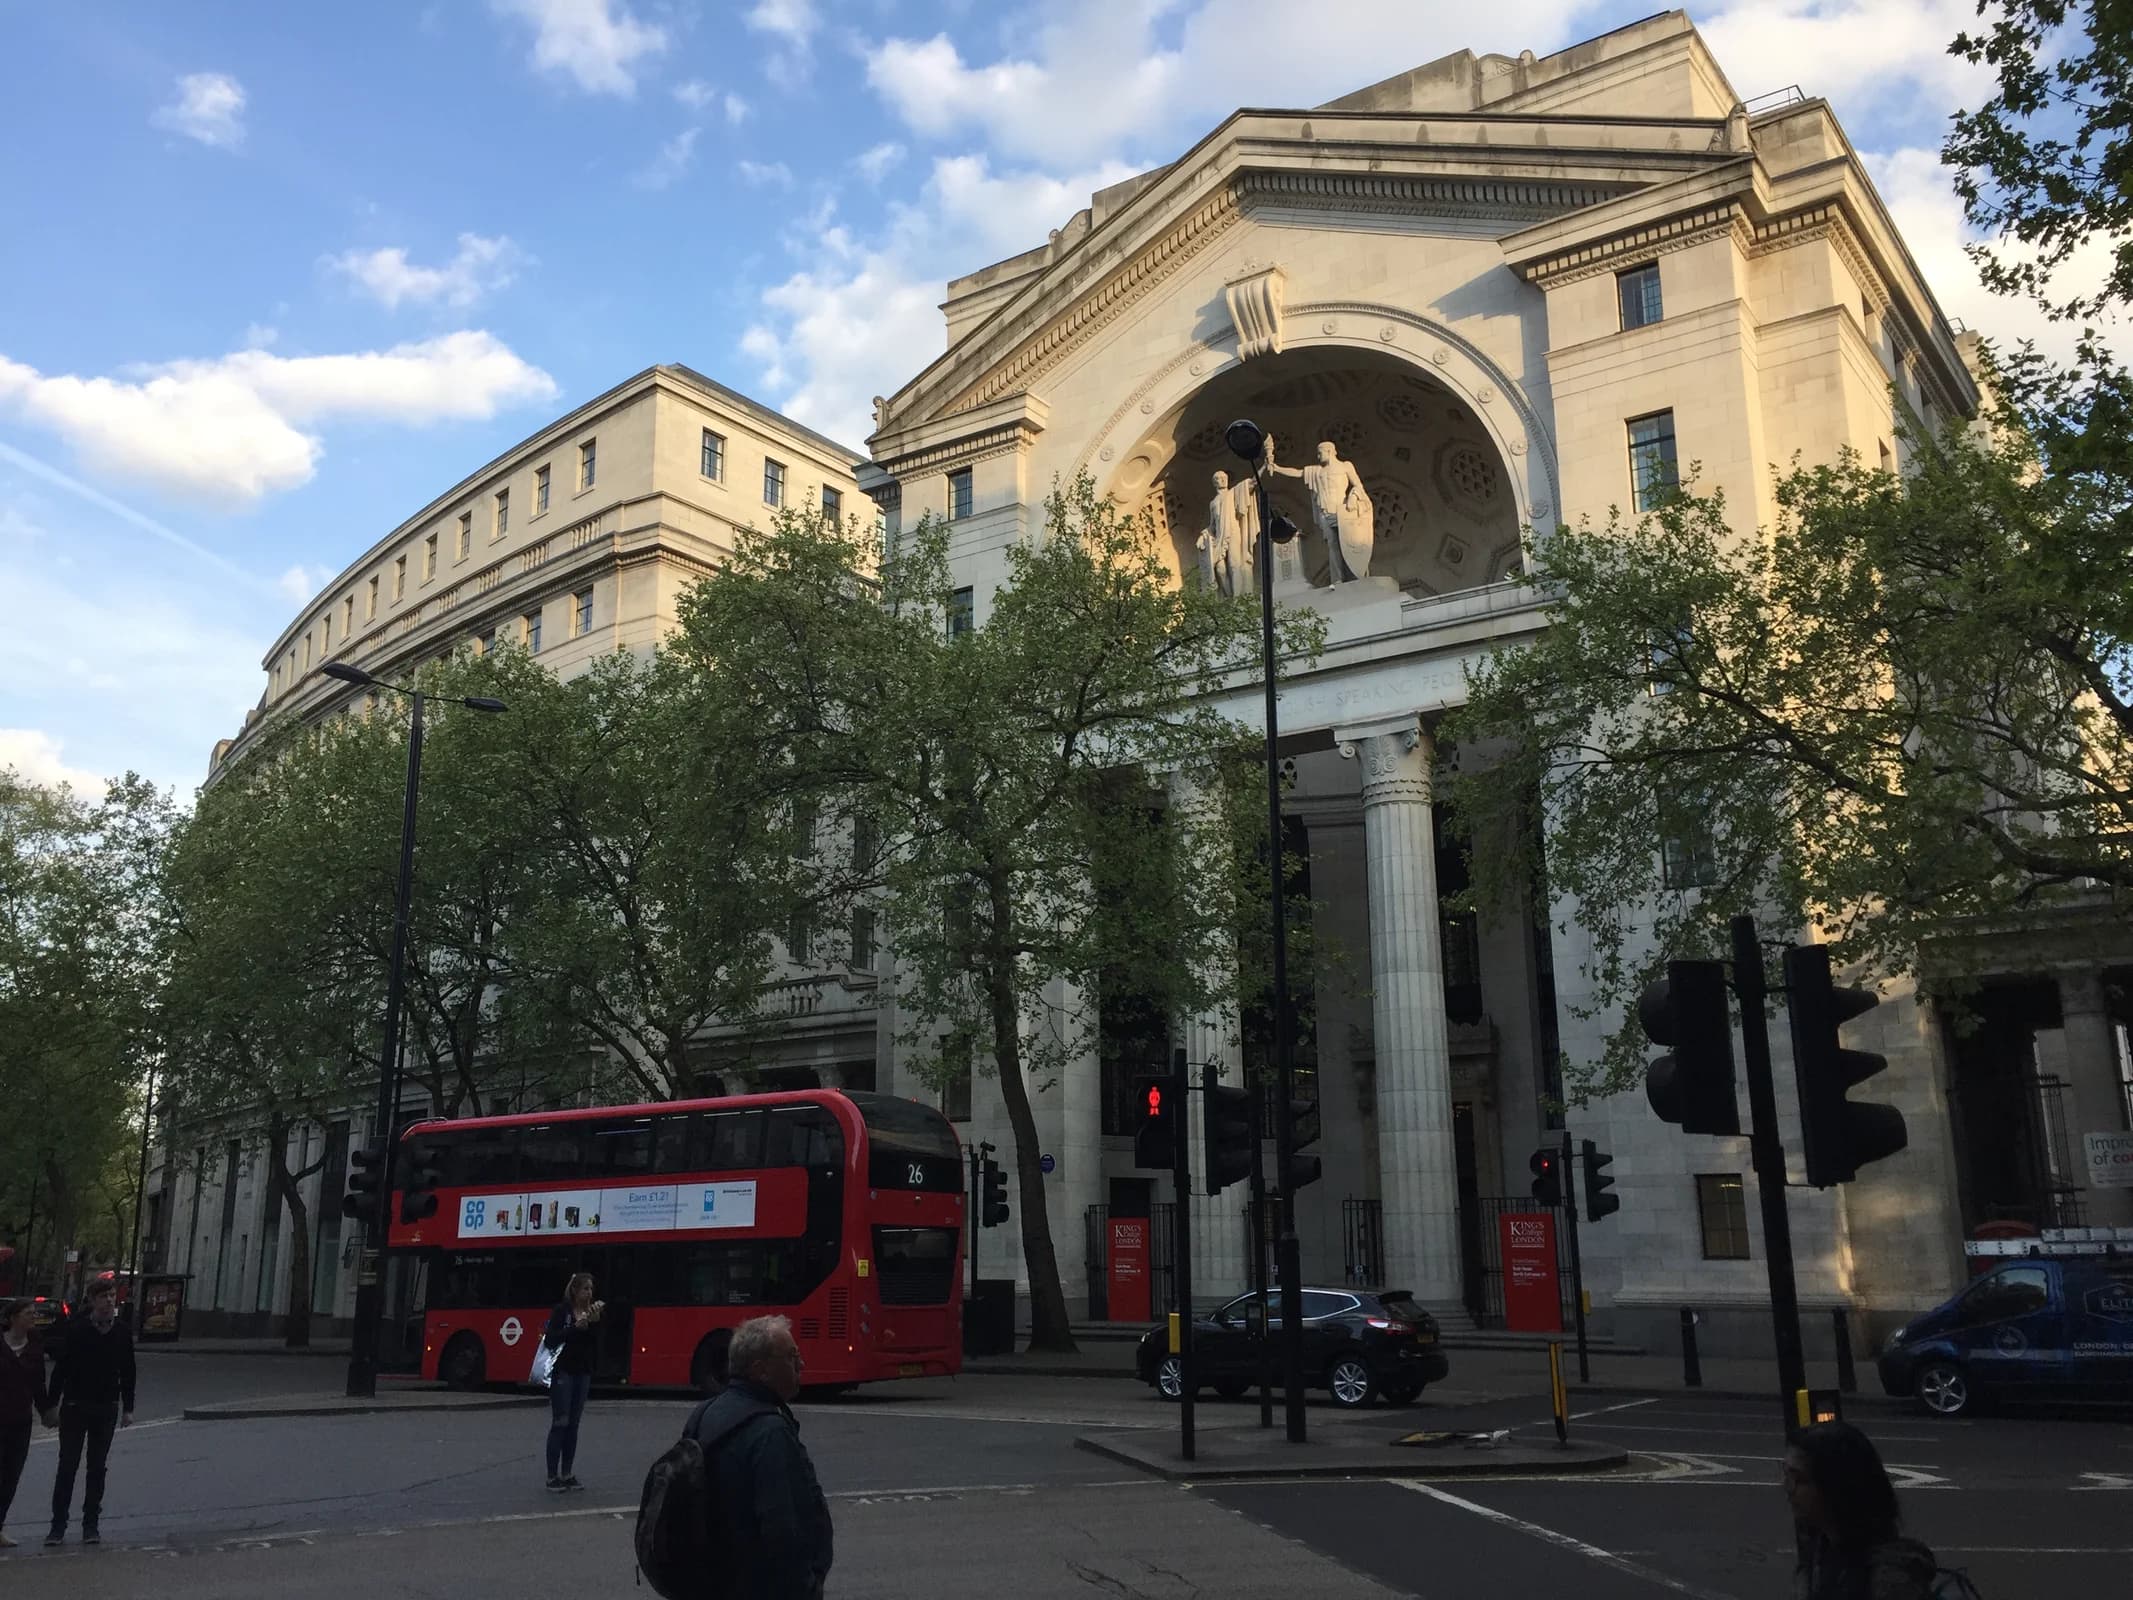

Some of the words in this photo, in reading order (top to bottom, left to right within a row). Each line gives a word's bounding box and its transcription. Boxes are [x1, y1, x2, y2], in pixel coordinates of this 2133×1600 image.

[2094, 1151, 2110, 1165] of
[908, 1163, 924, 1184] 26
[629, 1193, 647, 1202] Earn
[1115, 1238, 1142, 1246] LONDON
[1511, 1236, 1545, 1244] LONDON
[2102, 1297, 2133, 1310] ELIT
